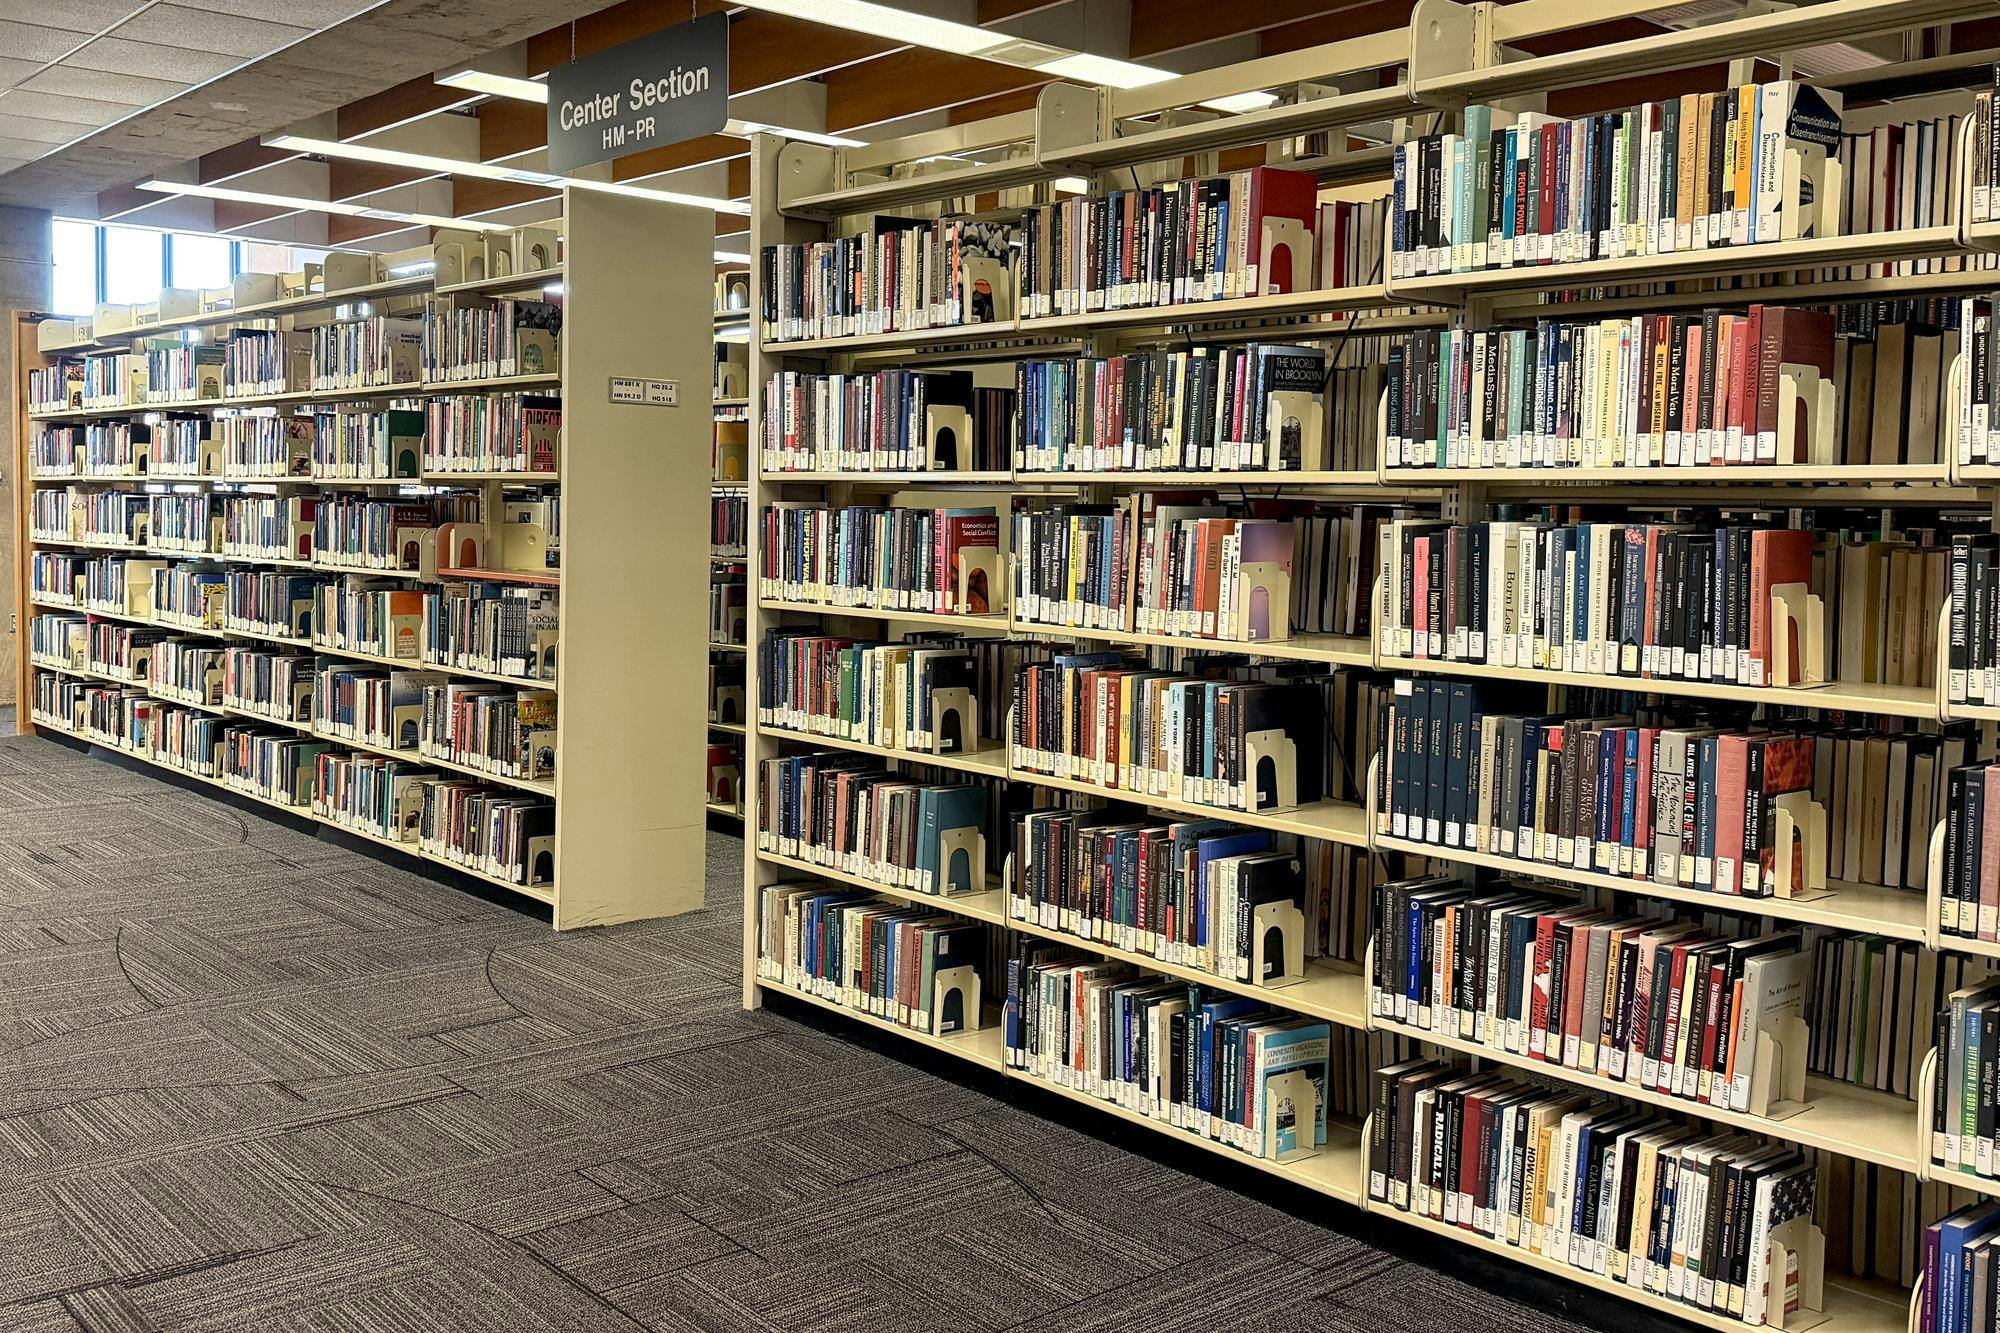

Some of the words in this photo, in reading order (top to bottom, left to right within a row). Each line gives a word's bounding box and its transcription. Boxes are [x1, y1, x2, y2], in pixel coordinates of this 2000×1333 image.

[560, 92, 620, 131] Center
[630, 66, 708, 110] Section
[1741, 112, 1749, 131] Bridging
[1792, 109, 1829, 128] Communication
[1790, 123, 1838, 144] Disenfranchisement
[1739, 140, 1747, 156] Digital
[1770, 132, 1780, 179] Communication
[1760, 134, 1770, 192] Disenfranchisement
[1518, 172, 1526, 202] PEOPLE
[1164, 197, 1174, 237] Prismatic
[1492, 193, 1501, 222] Community
[1516, 205, 1525, 235] POWER
[1161, 239, 1172, 283] Metropolis
[1277, 357, 1288, 368] THE
[1291, 358, 1315, 368] WORD
[1476, 346, 1484, 372] MEDIA
[1656, 353, 1664, 369] RICH,
[1672, 346, 1681, 365] The
[1733, 337, 1742, 374] CRUNCHY
[1275, 370, 1284, 379] IN
[1285, 370, 1321, 380] BROOKLYN
[1485, 346, 1496, 422] MediaSpeak
[1655, 372, 1663, 388] FREE,
[1670, 367, 1680, 394] Moral
[1746, 344, 1757, 398] WINNING
[1192, 378, 1200, 403] Boston
[1653, 401, 1662, 433] MISERABLE
[1669, 396, 1678, 417] Veto
[1112, 530, 1120, 590] CLEVELAND
[1953, 562, 1965, 612] CONFRONTING
[1952, 614, 1965, 646] VIOLENCE
[1567, 734, 1576, 772] FOOLING
[1687, 743, 1695, 756] BILL
[1686, 758, 1694, 777] AYERS
[1564, 774, 1573, 813] AMERICA
[1659, 776, 1669, 791] The
[1670, 778, 1680, 792] The
[1684, 780, 1695, 811] PUBLIC
[1658, 792, 1668, 820] Sixties
[1668, 795, 1680, 833] Movement
[1683, 813, 1693, 844] ENEMY
[1966, 817, 1974, 853] AMERICAN
[1965, 871, 1971, 880] TO
[1157, 872, 1167, 929] MEGA-PROJECTS
[1492, 917, 1500, 934] THE
[1489, 936, 1499, 969] HIDDEN
[1488, 972, 1497, 996] 1970s
[1667, 987, 1680, 1021] ILLIBERAL
[1631, 990, 1649, 1050] RADICALS
[1664, 1022, 1677, 1058] VANGUARD
[1718, 1033, 1727, 1063] revisited
[1968, 1045, 1978, 1080] DIFFUSION
[1968, 1082, 1976, 1091] OF
[1967, 1093, 1976, 1110] GOOD
[1433, 1112, 1444, 1169] RADICAL
[1589, 1165, 1598, 1192] CLASS
[1727, 1179, 1735, 1195] FACING
[1726, 1195, 1734, 1209] SOCIAL
[1741, 1199, 1750, 1209] UP,
[1584, 1207, 1594, 1234] NEWS
[1724, 1210, 1733, 1224] CLASS
[1739, 1211, 1748, 1232] SCORN
[1737, 1234, 1745, 1256] DOWN
